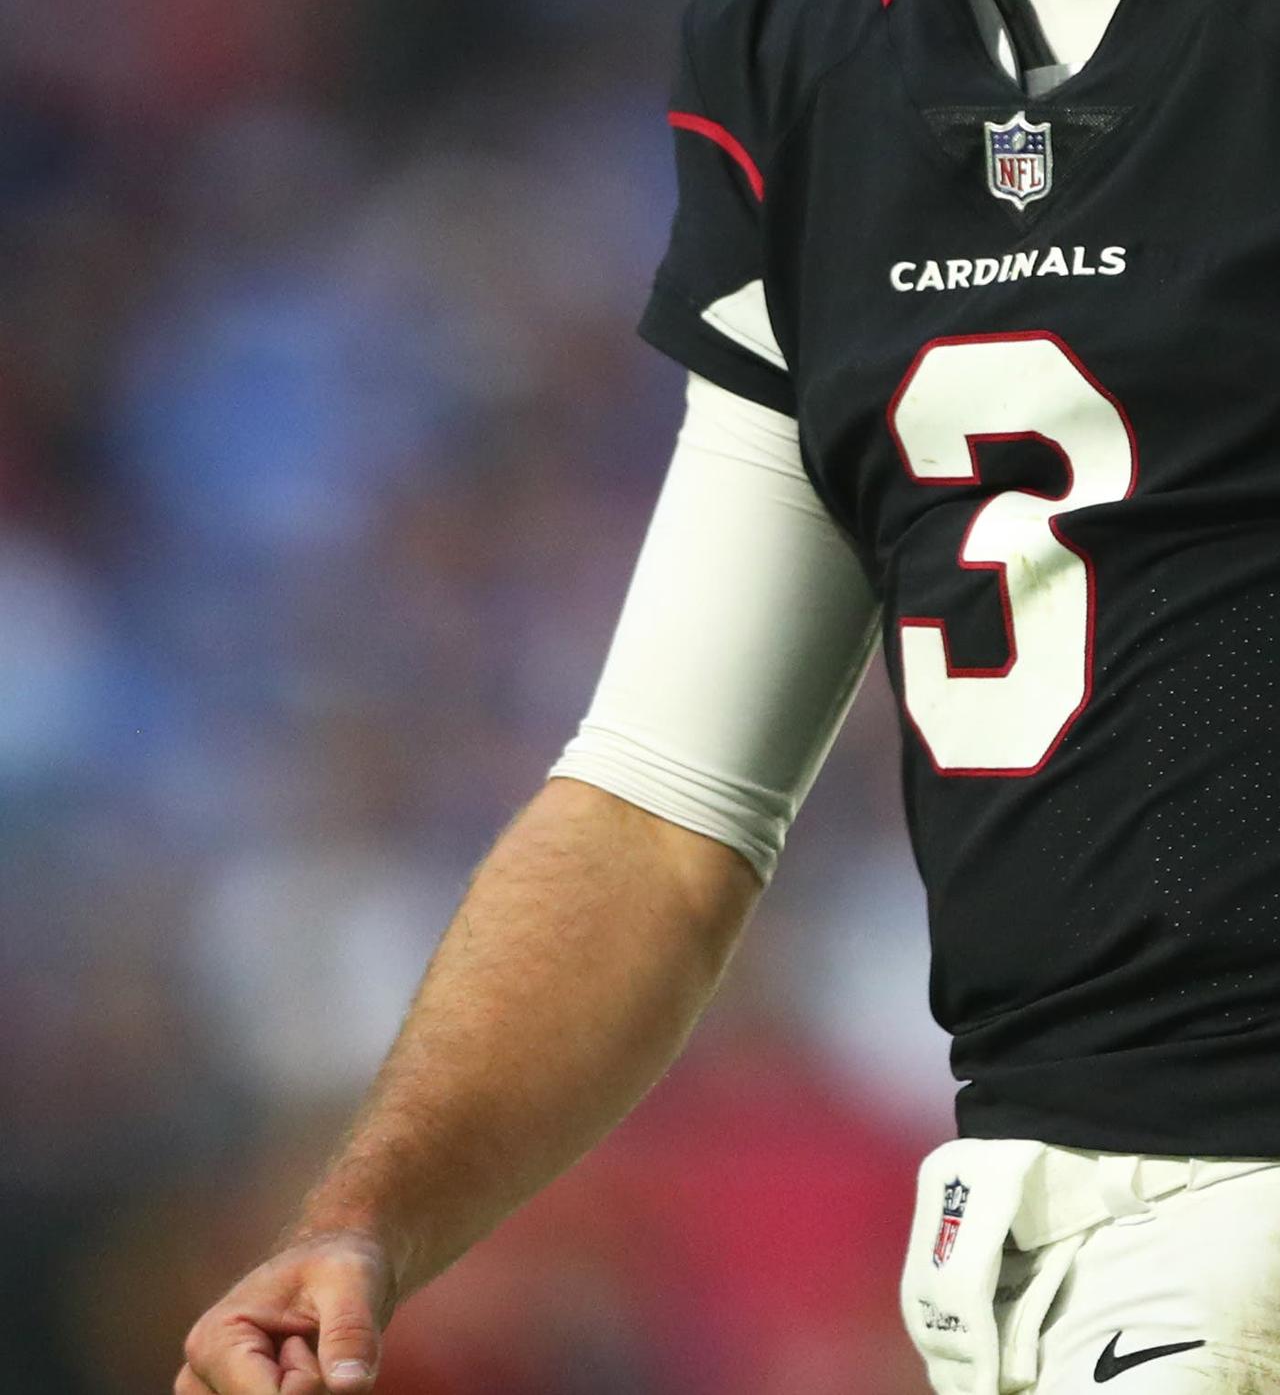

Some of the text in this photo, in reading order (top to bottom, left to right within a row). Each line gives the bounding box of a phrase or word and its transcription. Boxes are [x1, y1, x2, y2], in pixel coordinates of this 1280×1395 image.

[998, 157, 1041, 191] NFL
[890, 246, 1127, 292] CARDINALS
[887, 330, 1138, 777] 3
